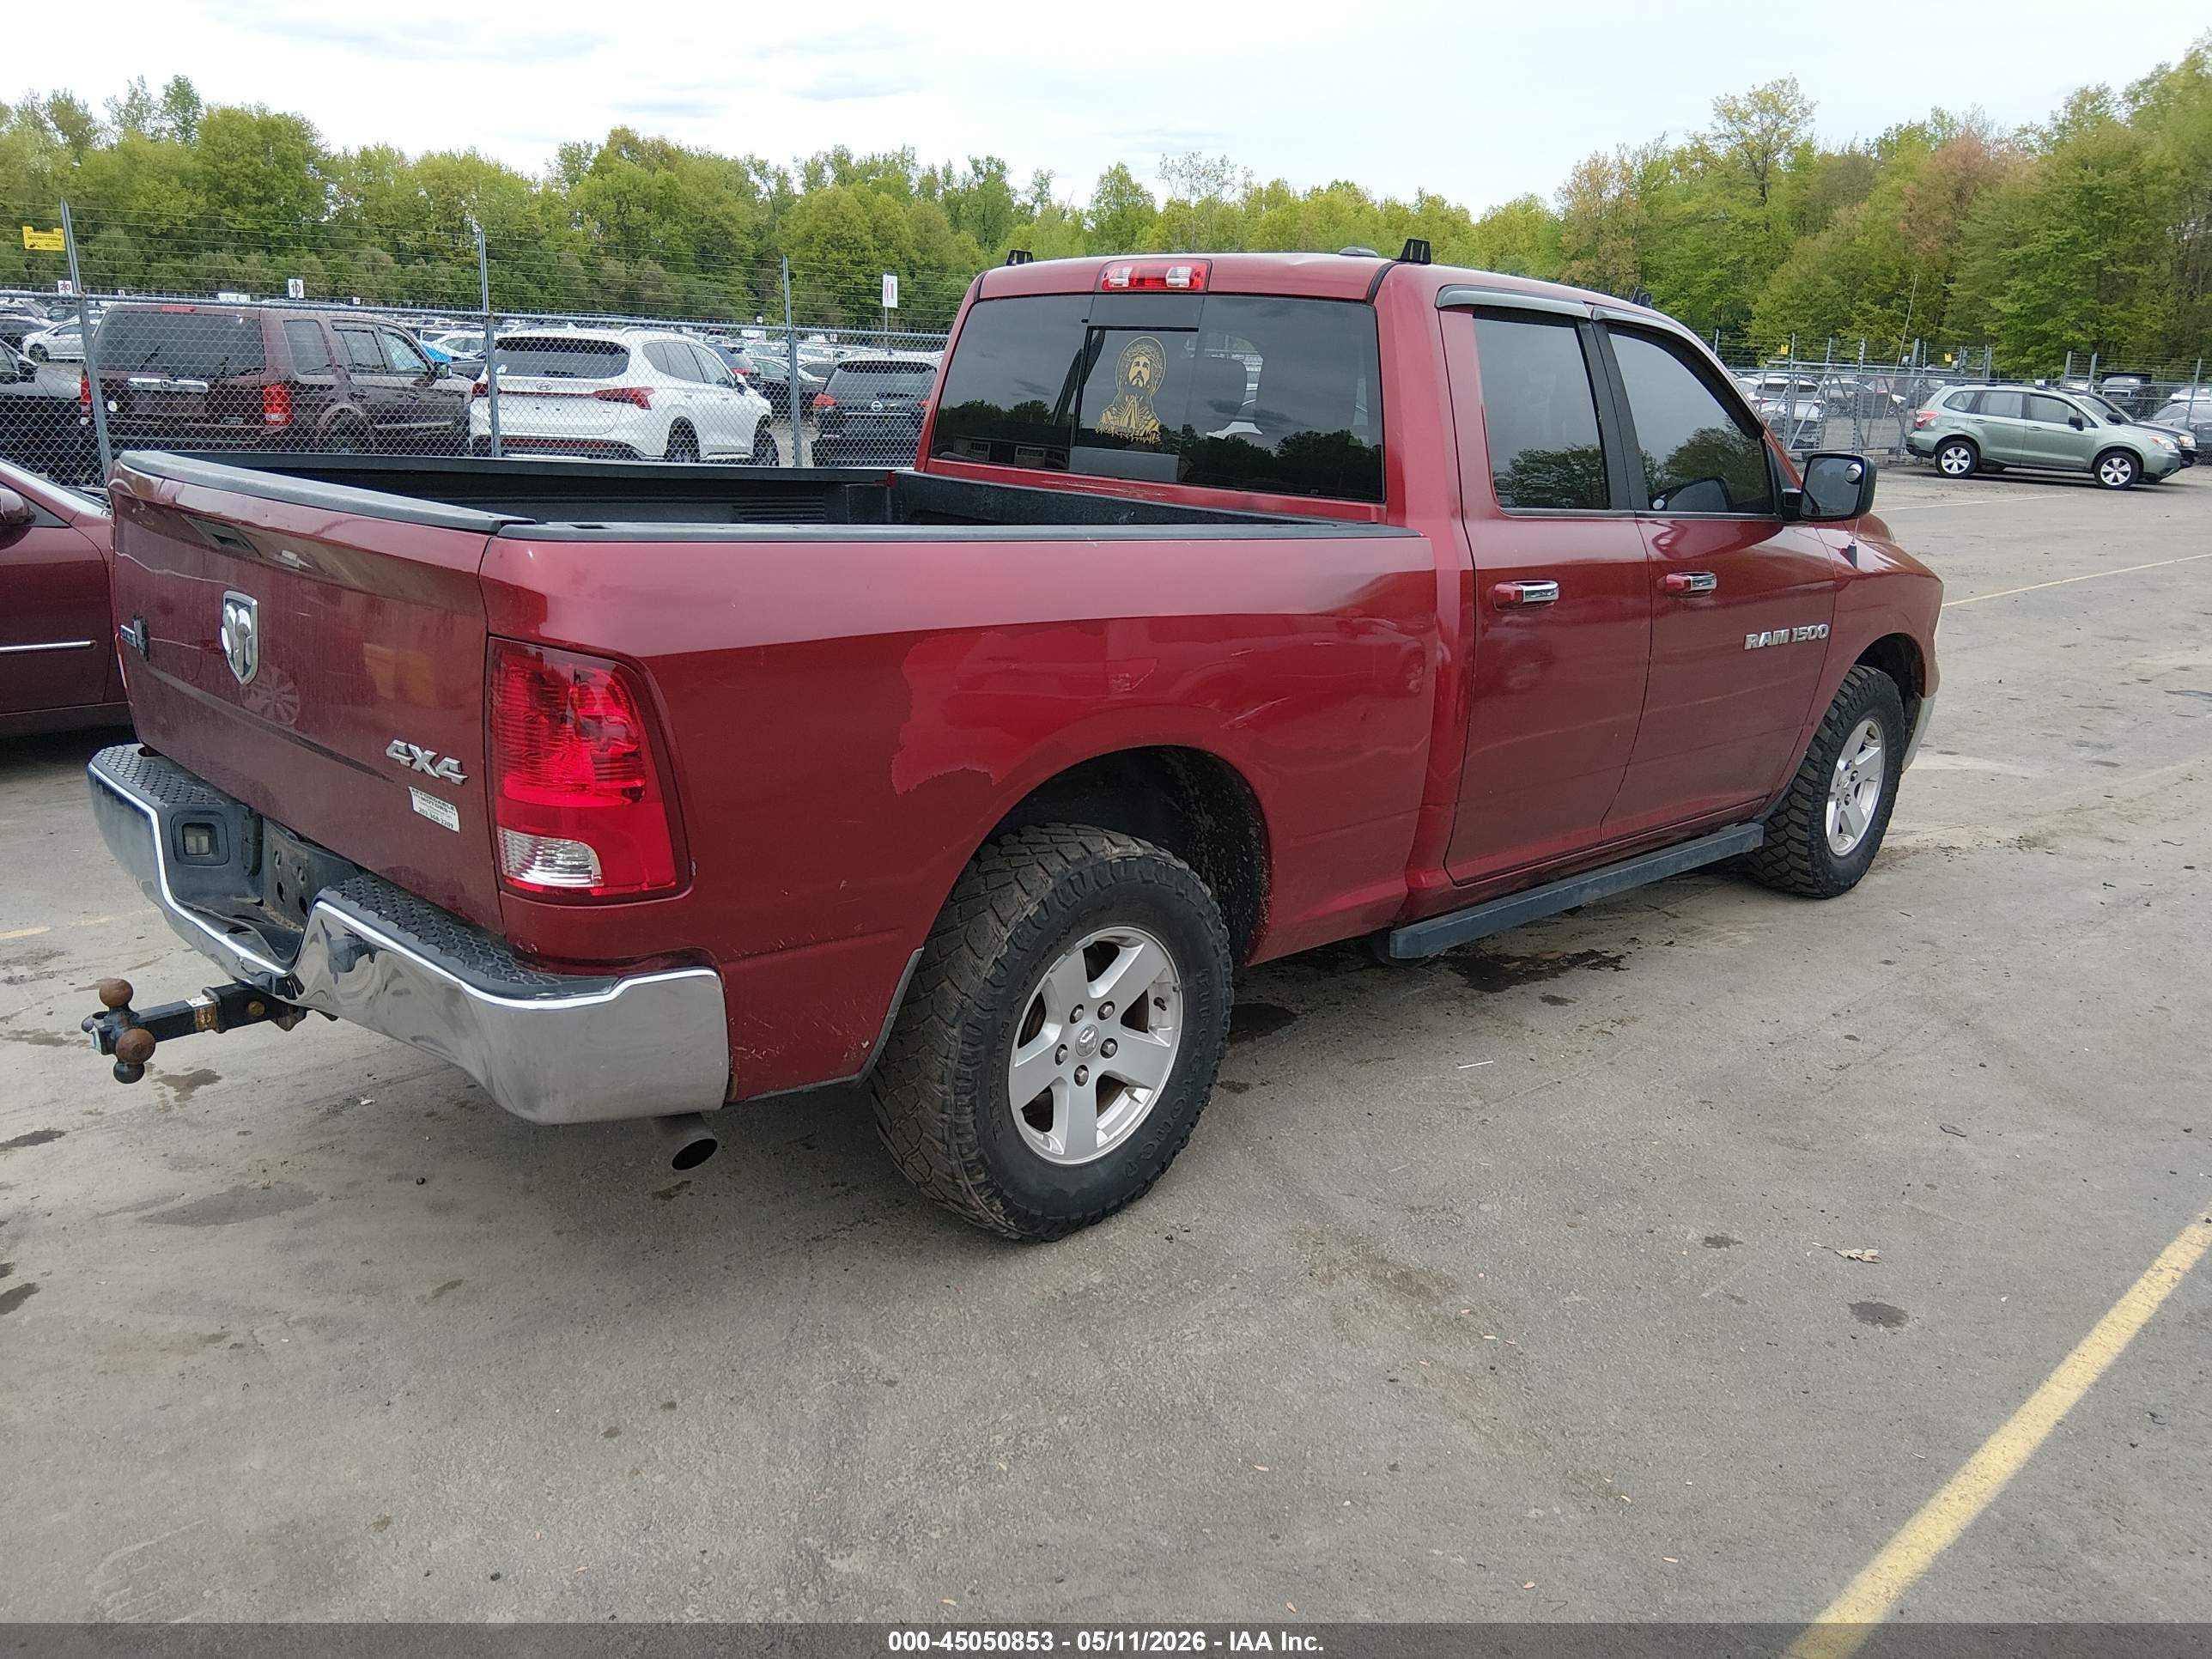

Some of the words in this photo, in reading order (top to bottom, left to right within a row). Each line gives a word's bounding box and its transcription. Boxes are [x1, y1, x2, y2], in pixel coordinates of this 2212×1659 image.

[290, 284, 301, 295] 10
[1744, 629, 1790, 650] RAM
[1790, 623, 1829, 642] 1500
